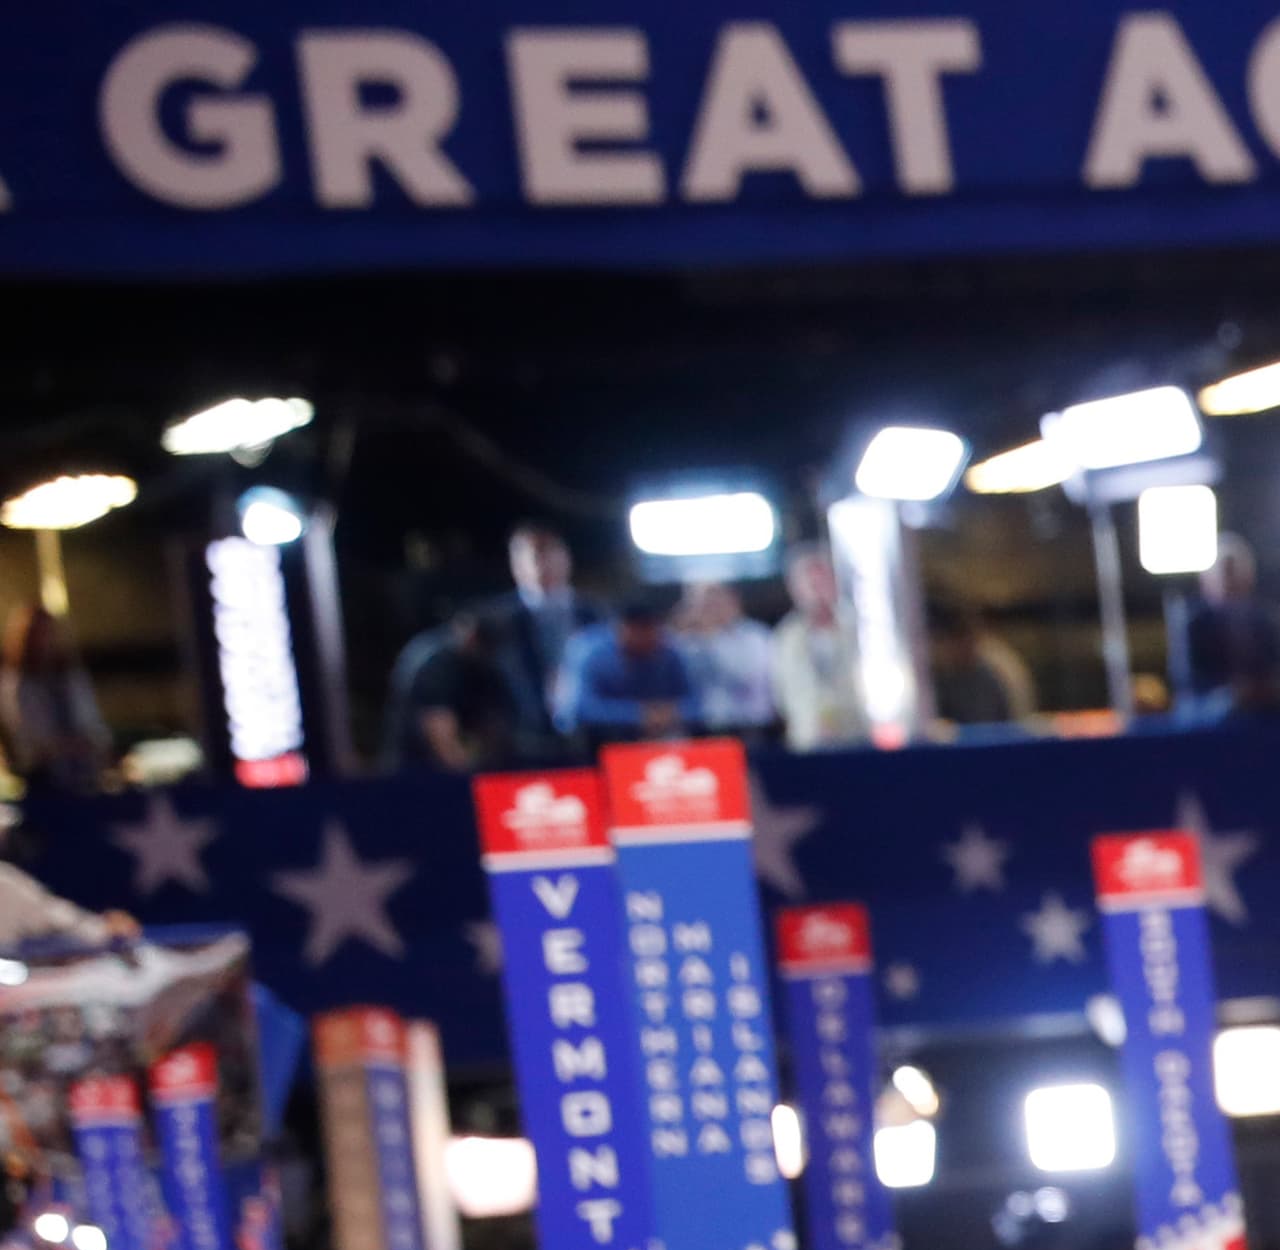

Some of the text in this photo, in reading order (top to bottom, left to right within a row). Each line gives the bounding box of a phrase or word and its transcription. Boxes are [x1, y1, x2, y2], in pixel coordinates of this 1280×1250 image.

[98, 18, 982, 210] GREAT
[532, 874, 621, 1244] VERMONT
[626, 891, 776, 1184] NORTHERN MARIANA ISLANDS
